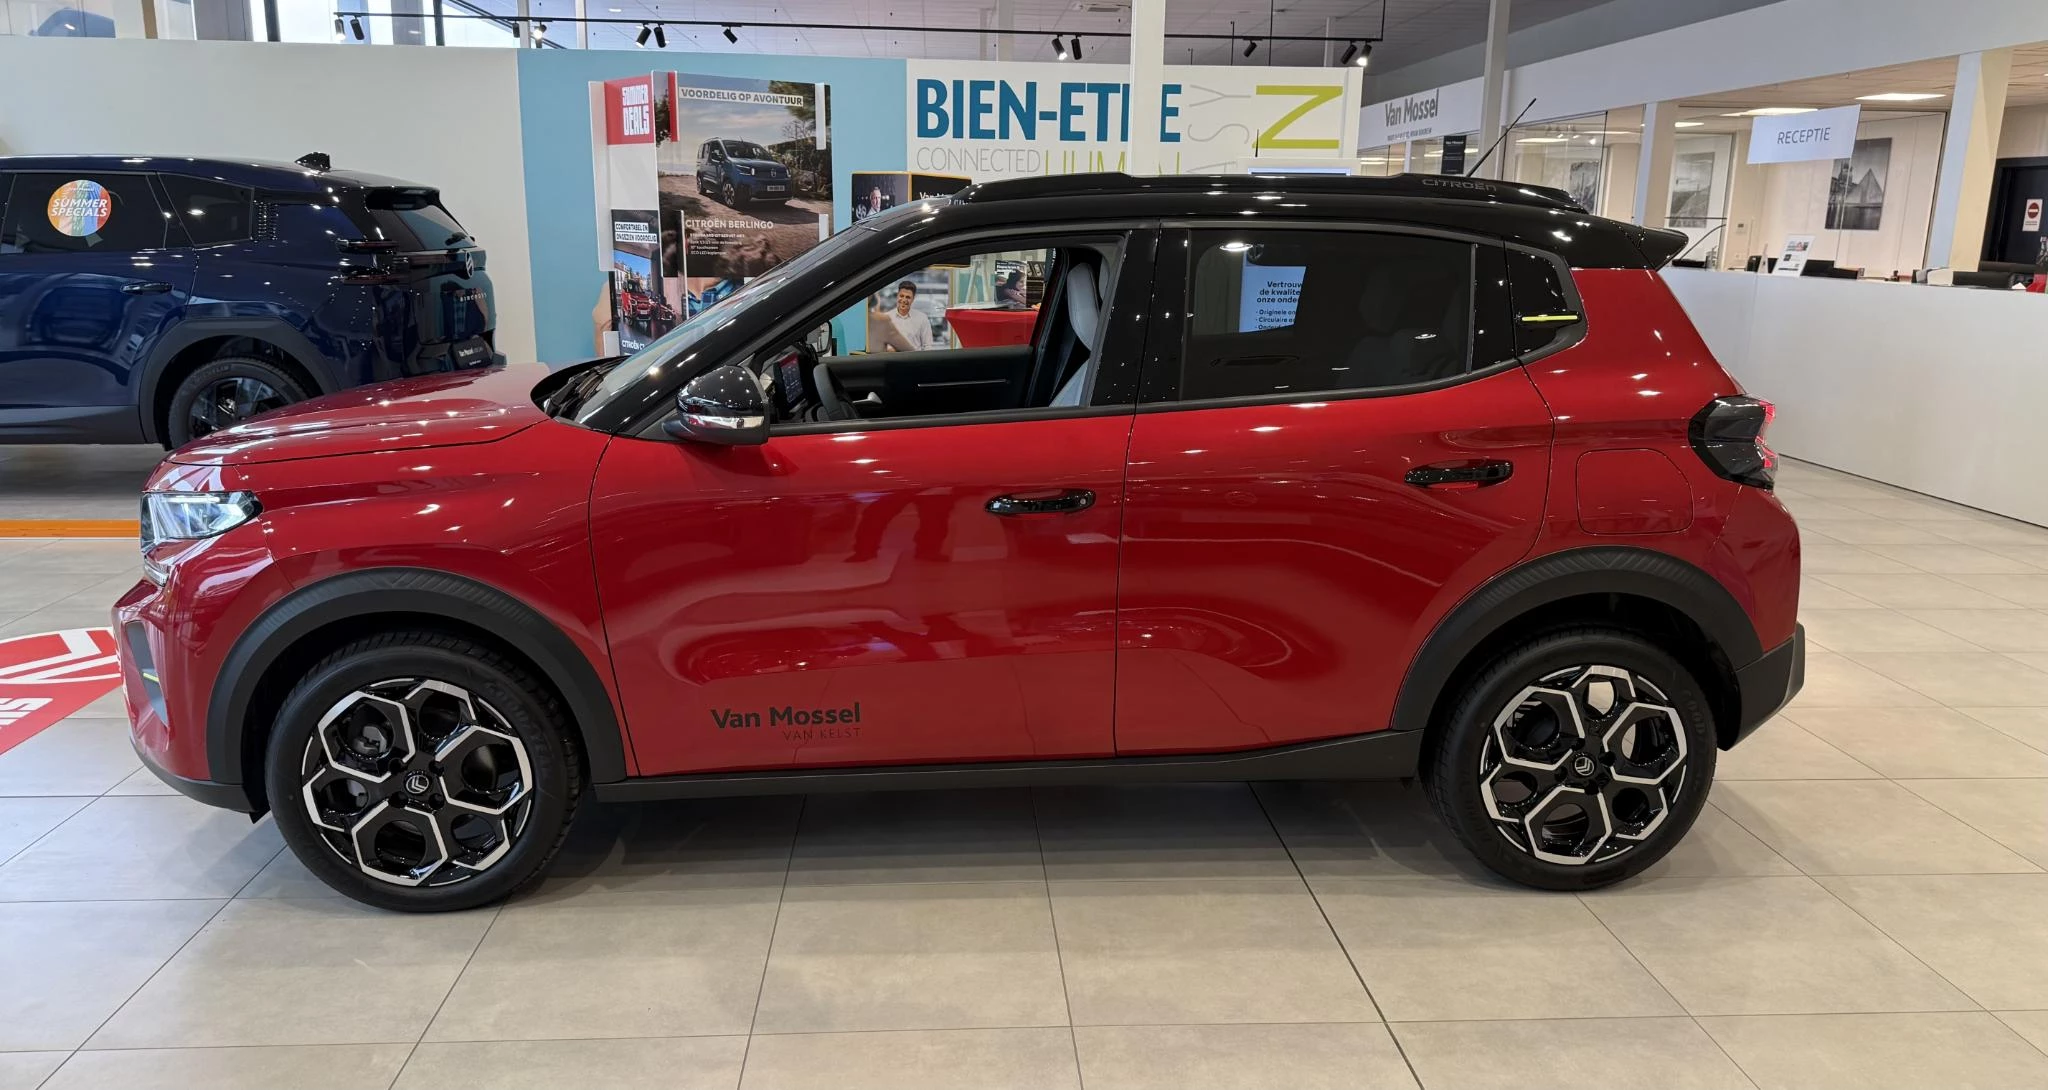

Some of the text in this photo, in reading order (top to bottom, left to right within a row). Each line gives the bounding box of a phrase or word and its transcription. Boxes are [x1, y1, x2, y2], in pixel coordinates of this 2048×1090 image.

[681, 88, 803, 106] VOORDELIG OP AVONTUUR
[1385, 88, 1440, 127] Van Mossel
[623, 105, 650, 136] DEALS
[1777, 127, 1831, 144] RECEPTIE
[916, 146, 1041, 173] CONNECTED
[53, 198, 108, 208] SUMMER
[51, 207, 108, 217] SPECIALS
[685, 219, 774, 229] CITROËN BERLINGO
[710, 702, 860, 729] Van Mossel
[782, 730, 813, 741] VAN
